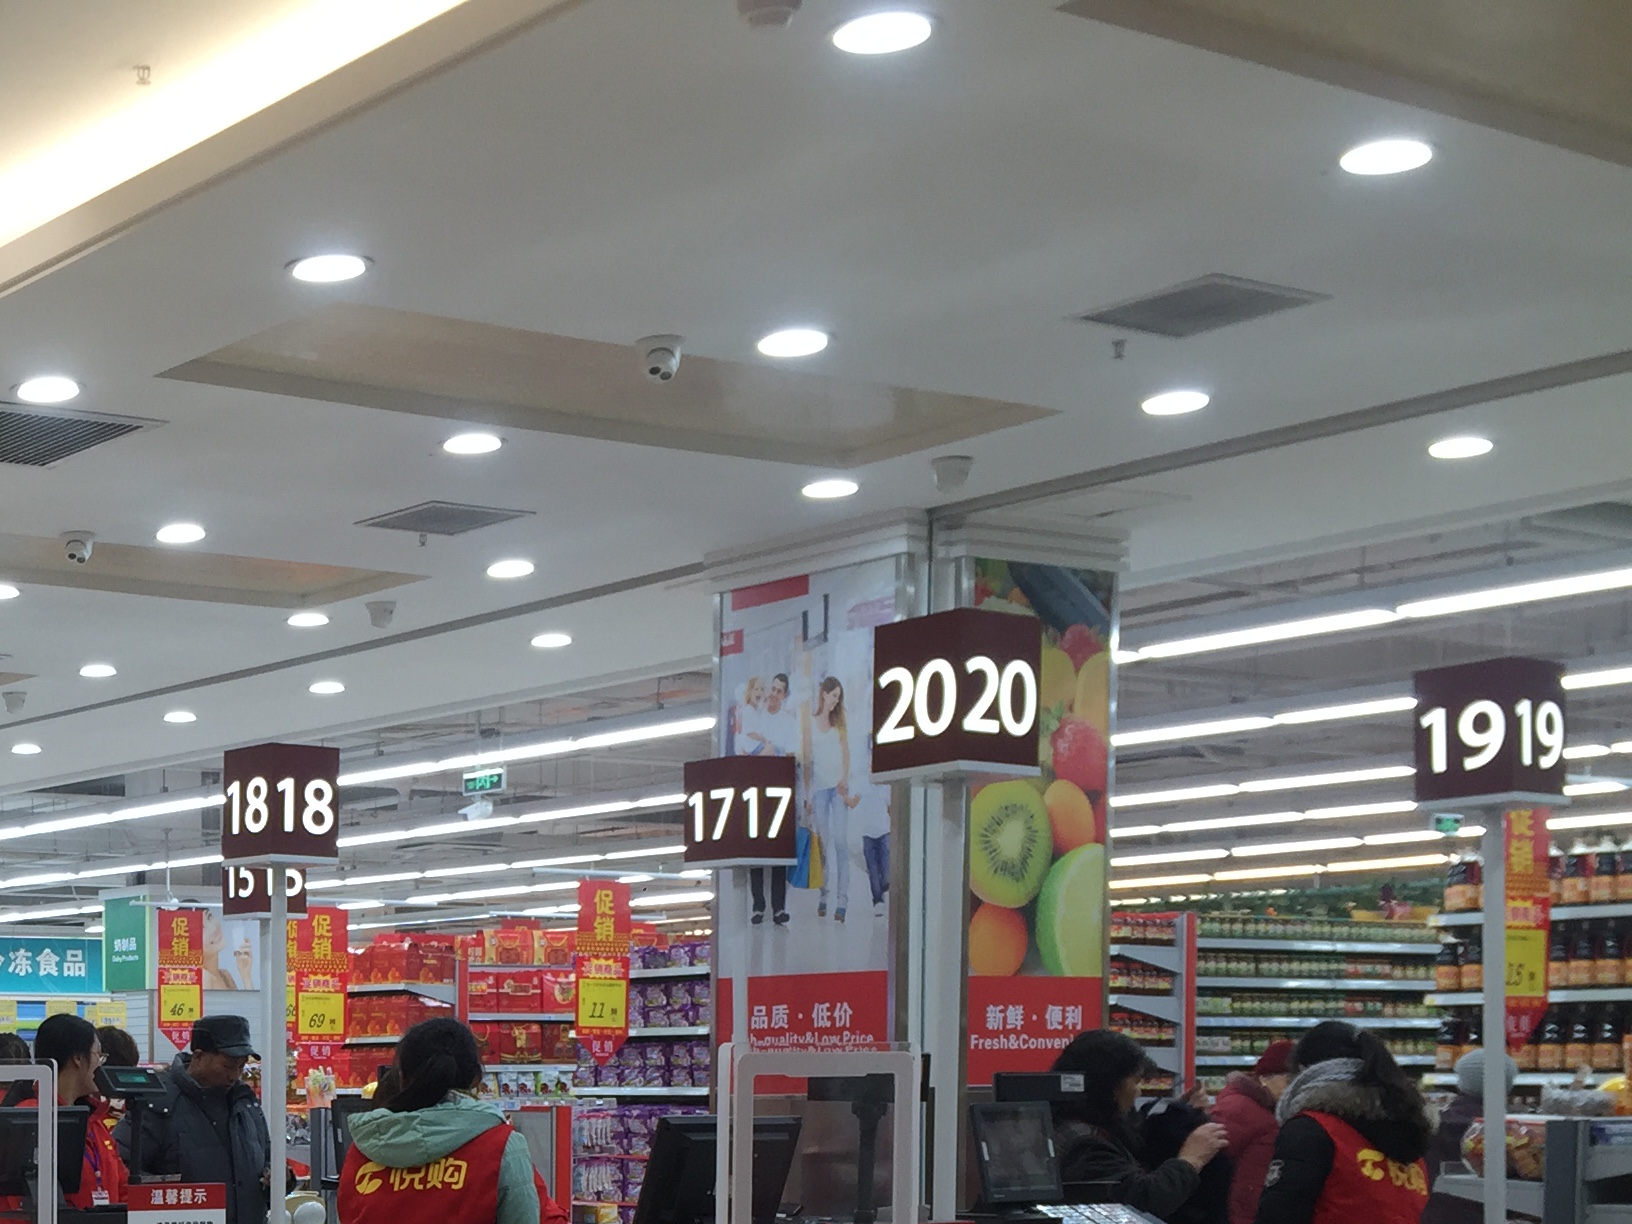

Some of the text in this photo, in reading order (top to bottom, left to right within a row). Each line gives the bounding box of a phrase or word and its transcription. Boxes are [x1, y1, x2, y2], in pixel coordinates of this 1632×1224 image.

[875, 658, 958, 745] 20
[962, 655, 1038, 738] 20
[1419, 699, 1507, 775] 19
[1514, 698, 1566, 769] 19
[226, 775, 269, 835] 18
[276, 777, 335, 836] 18
[687, 787, 735, 842] 17
[741, 787, 793, 840] 17
[171, 916, 190, 957] 促销
[312, 914, 334, 960] 促销
[593, 889, 616, 942] 促销
[169, 1003, 186, 1017] 46
[308, 1013, 326, 1029] 69
[588, 1001, 607, 1019] 11
[751, 1001, 854, 1030] 品质·低价
[985, 1003, 1084, 1031] 新鲜·便利
[970, 1034, 1074, 1051] Fresh&Conven
[150, 1188, 207, 1205] 温馨提示
[389, 1157, 469, 1192] 悦购
